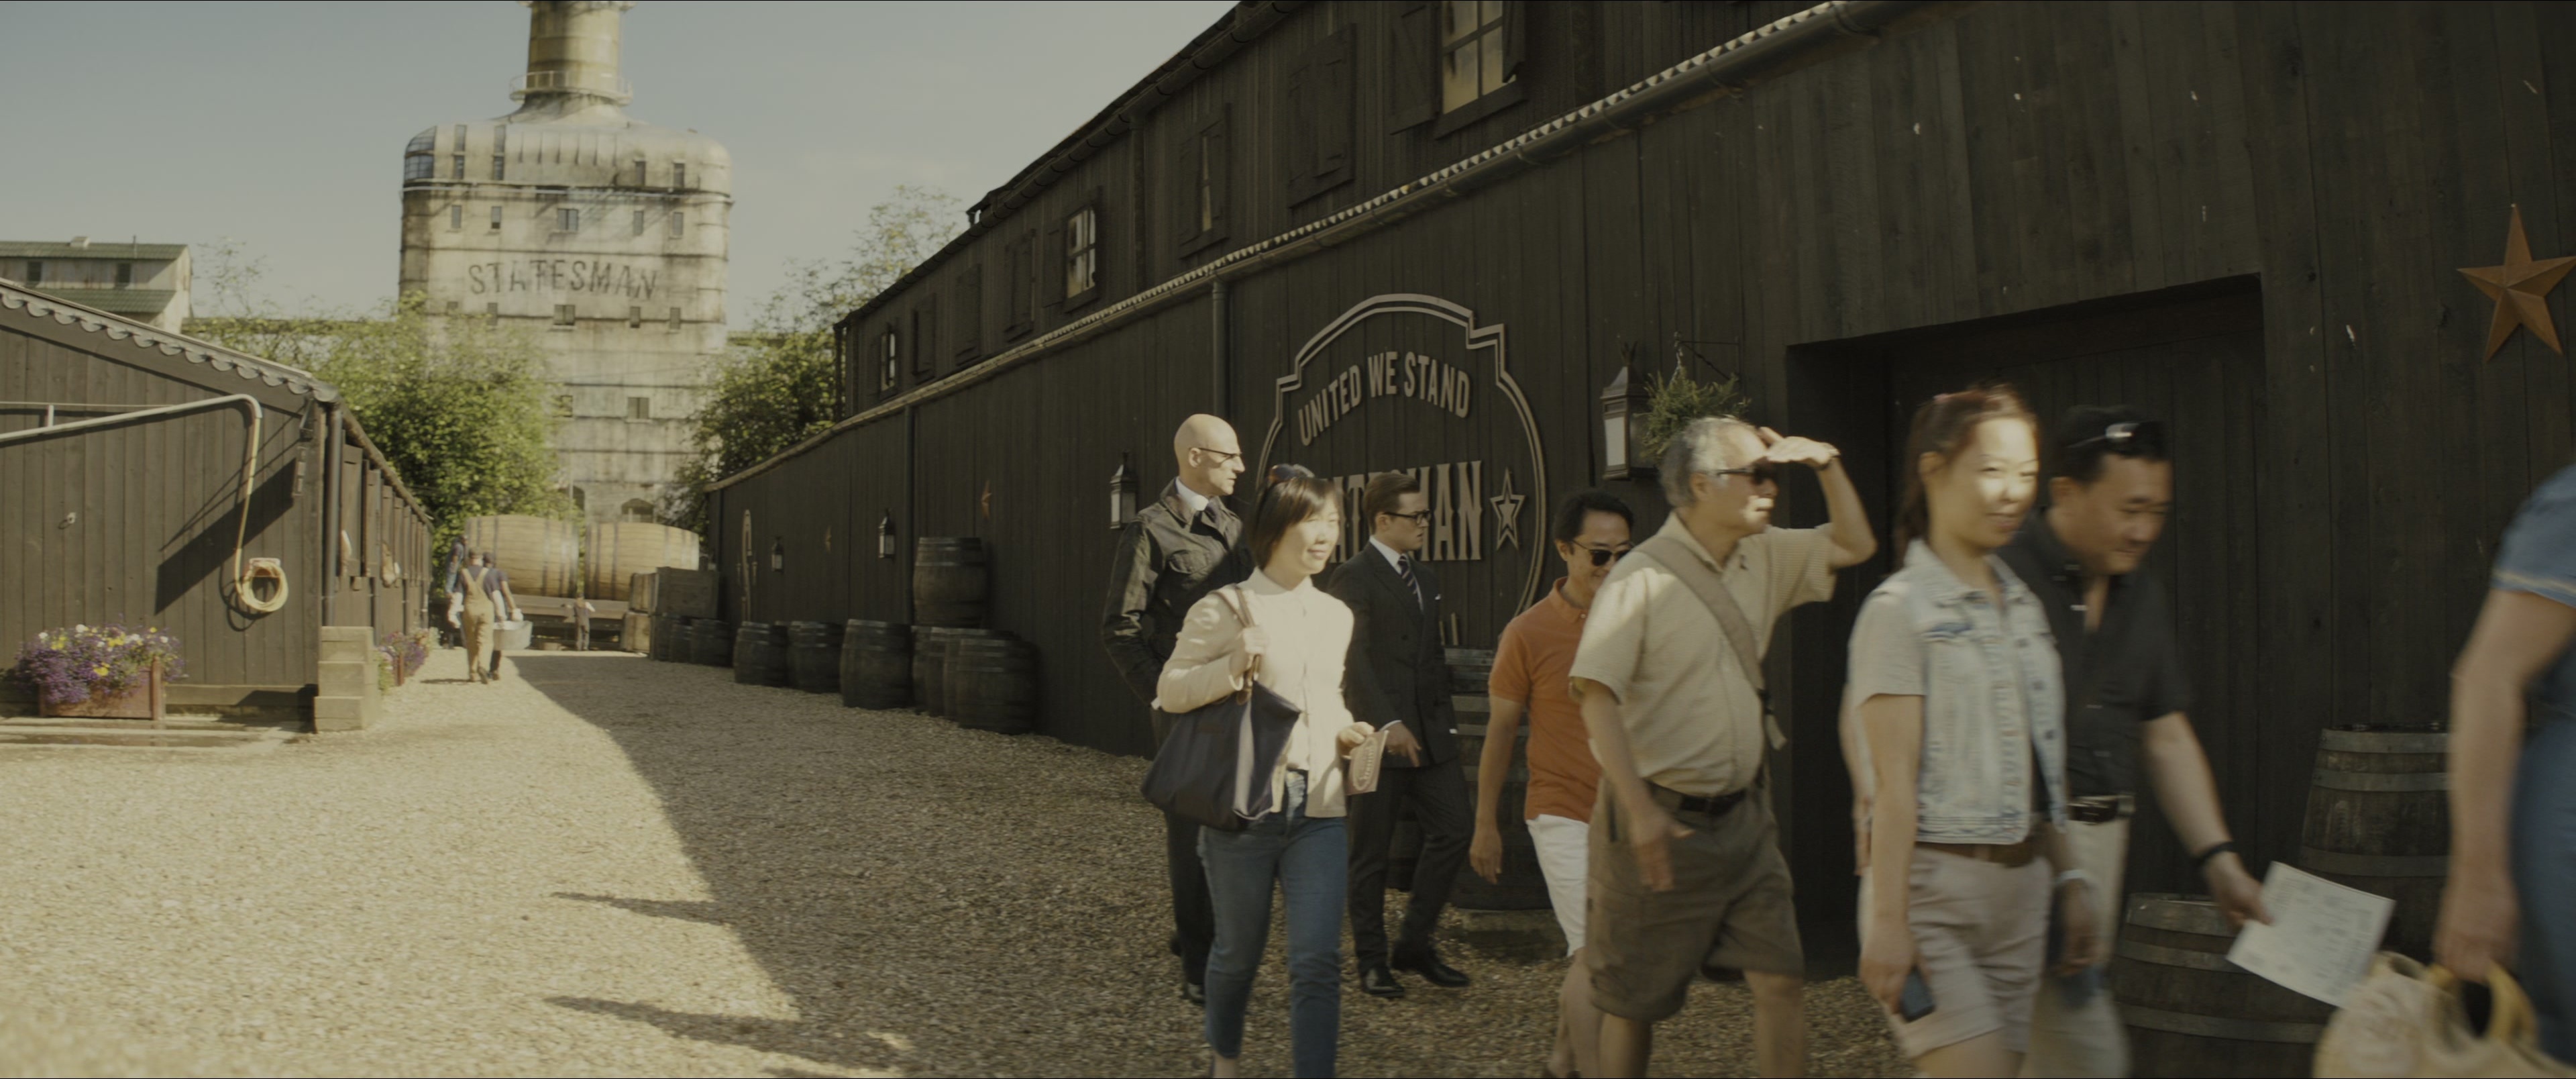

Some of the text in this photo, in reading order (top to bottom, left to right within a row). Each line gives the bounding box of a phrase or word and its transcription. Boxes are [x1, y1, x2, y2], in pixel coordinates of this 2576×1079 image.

[469, 259, 658, 299] STATESMAN
[1298, 350, 1471, 446] UNITED WE STAND
